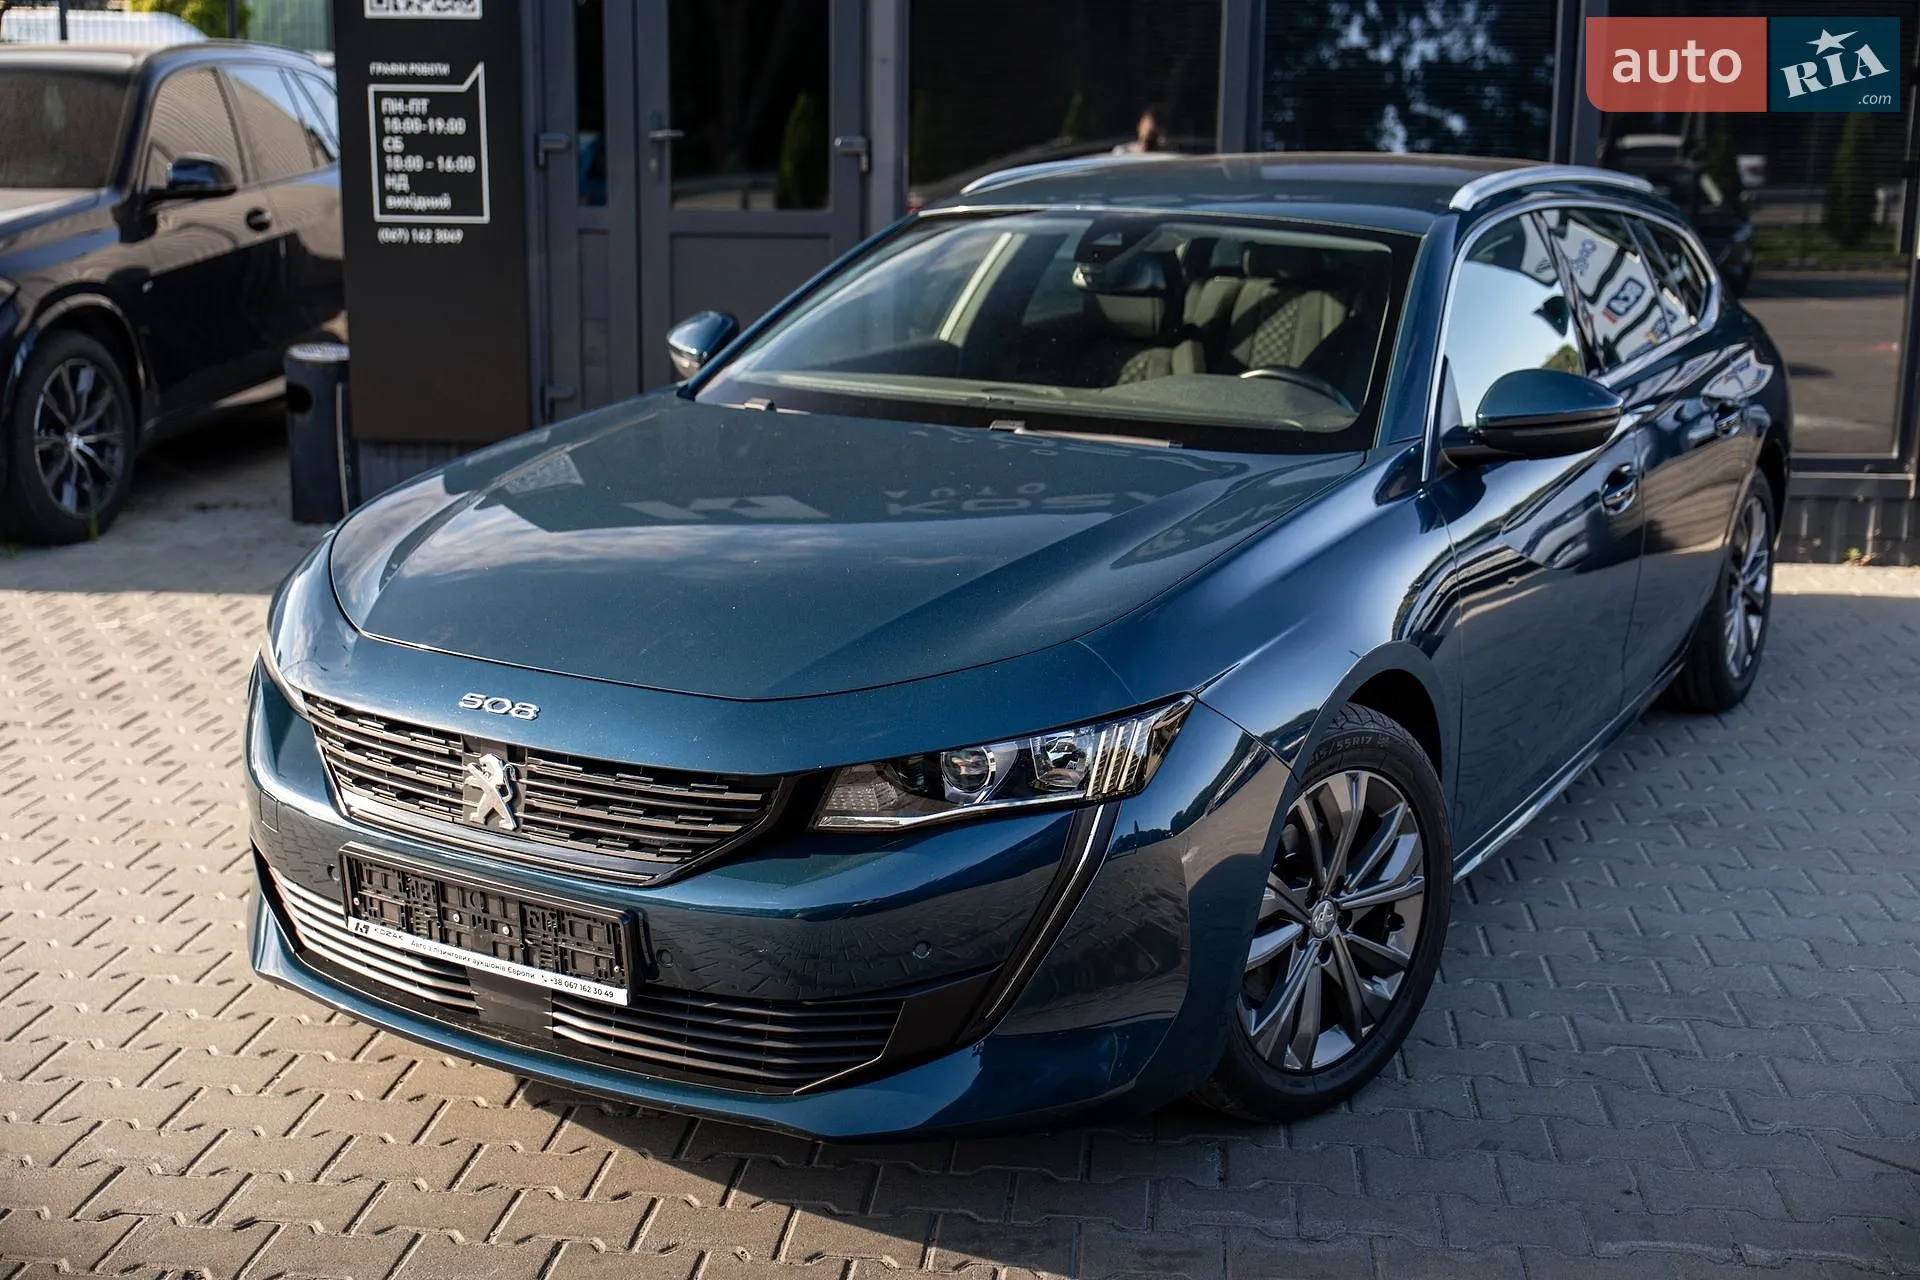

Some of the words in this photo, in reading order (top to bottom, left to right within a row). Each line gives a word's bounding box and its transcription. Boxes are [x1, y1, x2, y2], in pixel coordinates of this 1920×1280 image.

[381, 97, 429, 115] ПН-ПТ
[382, 136, 405, 153] СБ
[384, 173, 410, 193] НД
[459, 692, 540, 720] 508
[374, 927, 404, 941] KOZAK
[411, 940, 426, 950] Авто
[507, 966, 536, 979] Європи
[550, 977, 563, 986] +38
[564, 980, 578, 990] 067
[579, 984, 592, 994] 162
[593, 987, 603, 996] 30
[604, 990, 614, 998] 49
